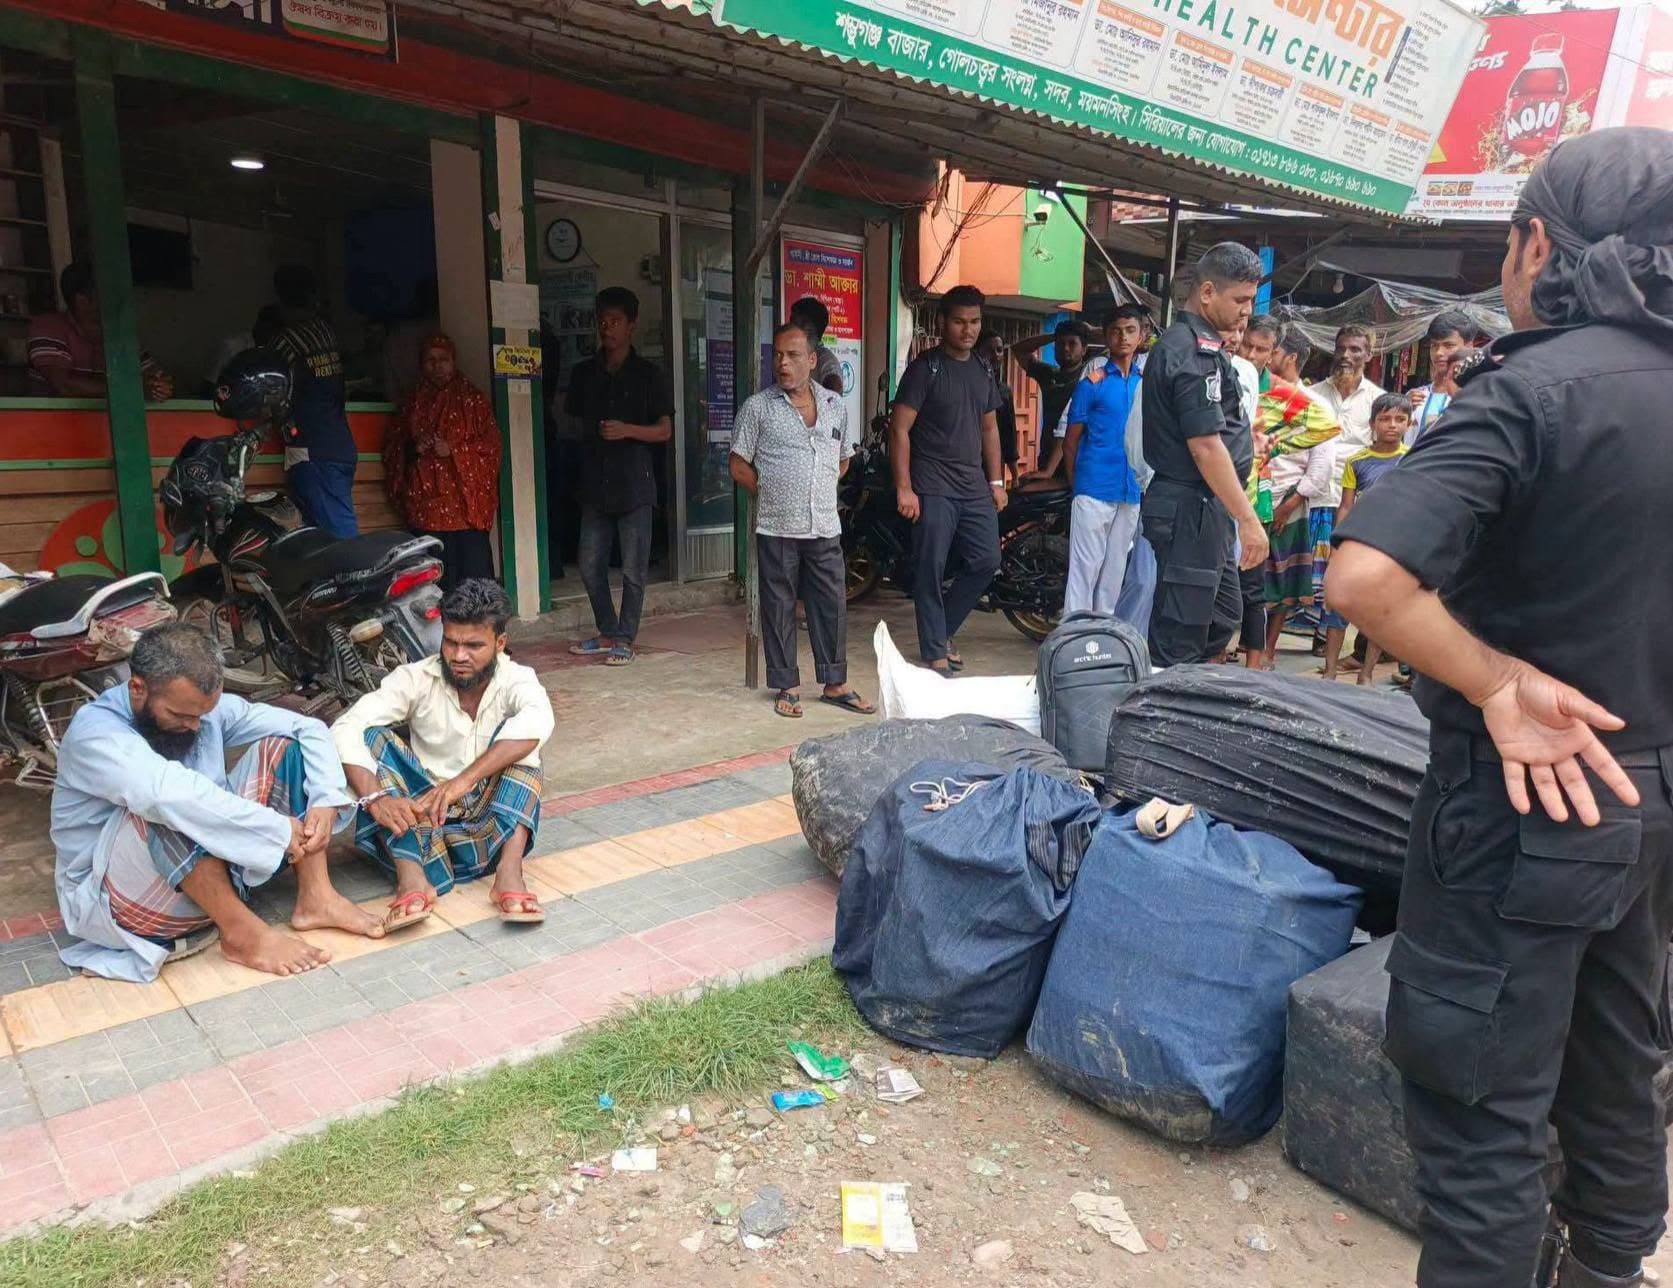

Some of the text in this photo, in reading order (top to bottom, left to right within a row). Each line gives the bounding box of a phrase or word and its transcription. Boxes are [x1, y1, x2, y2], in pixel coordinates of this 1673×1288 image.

[835, 11, 882, 50] শম্ভুগঞ্জ
[887, 28, 933, 70] বাজার,
[1044, 79, 1072, 112] সদর,
[1187, 124, 1208, 146] জন্য
[1285, 38, 1379, 98] CENTER
[1507, 101, 1560, 141] MOJO
[829, 275, 859, 293] আক্তার
